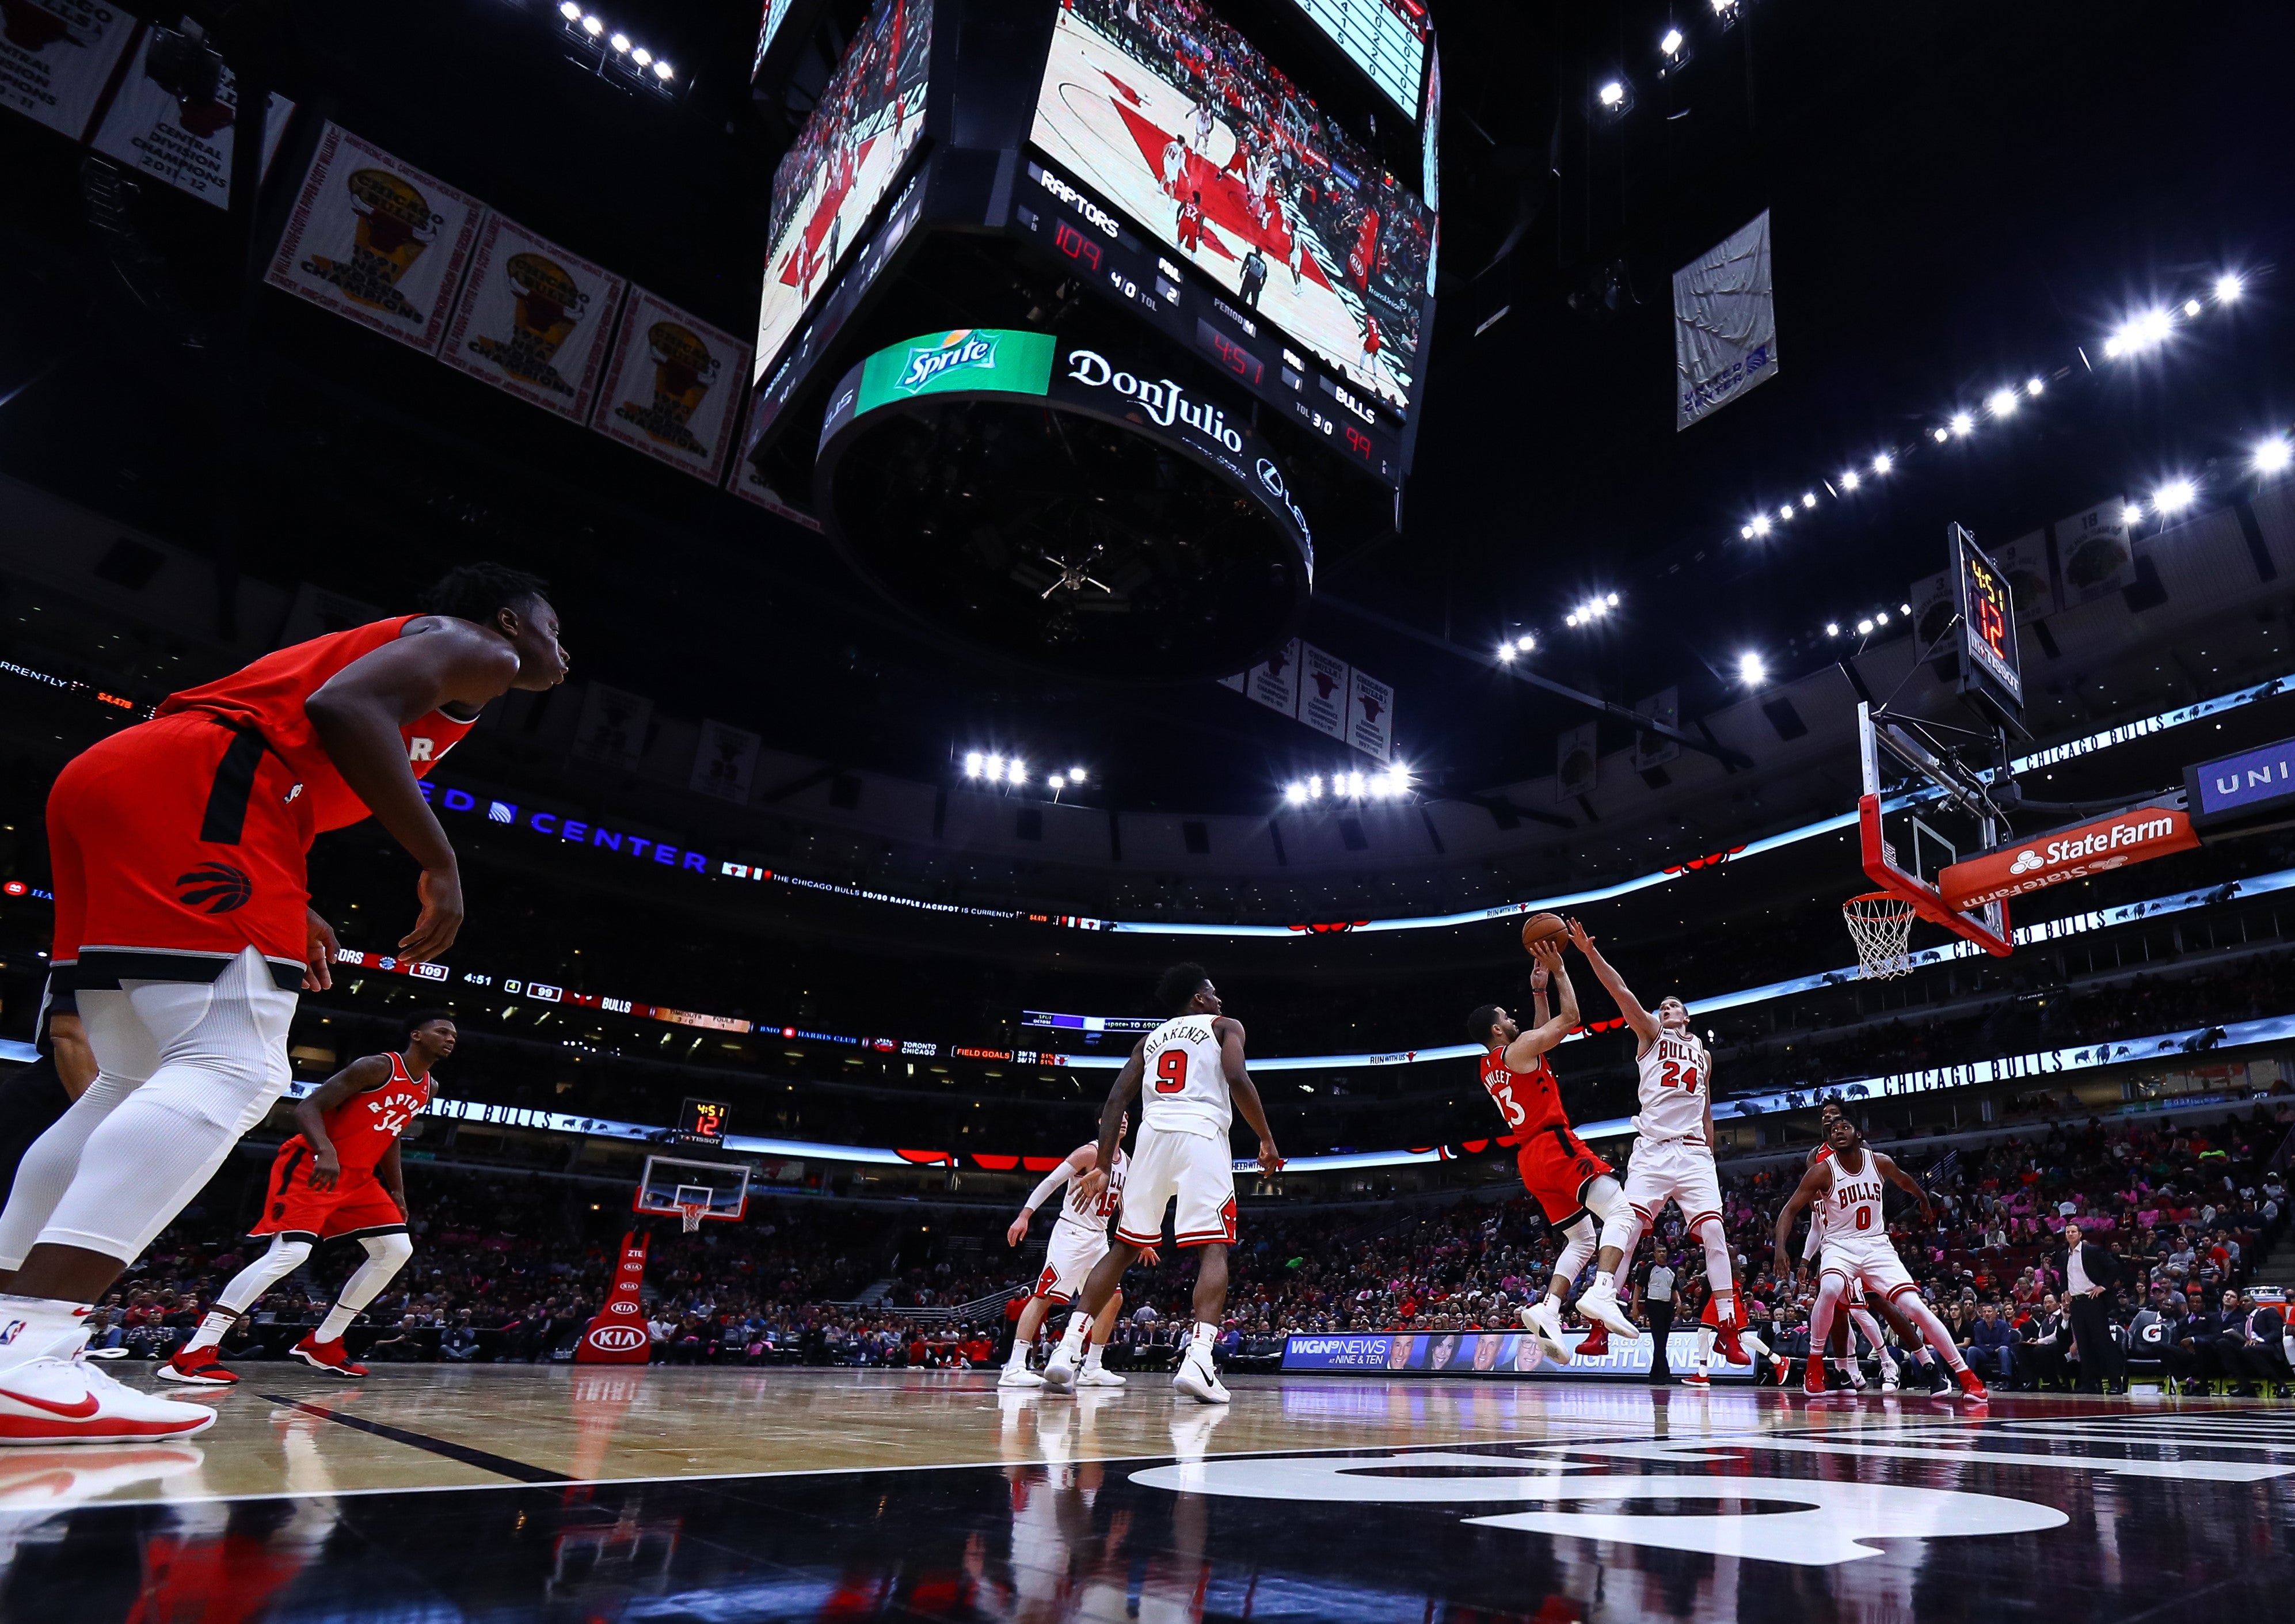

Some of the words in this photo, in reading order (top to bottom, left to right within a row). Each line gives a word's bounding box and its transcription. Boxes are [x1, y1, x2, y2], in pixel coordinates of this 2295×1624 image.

[1375, 16, 1381, 28] 0
[1373, 32, 1380, 45] 2
[1406, 31, 1412, 43] 0
[1372, 48, 1378, 60] 2
[1404, 46, 1410, 58] 0
[1369, 64, 1376, 76] 0
[1400, 77, 1407, 89] 0
[150, 132, 220, 172] DIVISION
[157, 123, 222, 160] CENTRAL
[131, 138, 226, 188] CHAMPIONS
[357, 174, 444, 225] CHICAGO
[371, 193, 429, 230] BULLS
[1041, 170, 1119, 238] RAPTORS
[1056, 225, 1101, 270] 109
[300, 260, 424, 325] CHAMPIONS
[516, 260, 590, 303] CHICAGO
[1166, 287, 1177, 303] 2
[1141, 292, 1157, 311] TOL
[1214, 298, 1243, 325] PERIOD
[1243, 320, 1254, 334] 4
[467, 341, 575, 398] CHAMPIONS
[903, 338, 987, 389] Sprite
[1215, 334, 1262, 384] 4:51
[1684, 363, 1741, 401] UNITED
[1296, 402, 1310, 418] TOL
[1335, 386, 1375, 425] BULLS
[1346, 427, 1372, 459] 99
[1972, 560, 2005, 612] 4:51
[1980, 598, 2004, 660] 12
[0, 661, 68, 687] RRENTLY
[1308, 650, 1342, 672] CHICAGO
[1985, 649, 2019, 691] TISSOT
[1357, 675, 1388, 696] CHICAGO
[2026, 737, 2099, 771] CHICAGO
[2110, 714, 2164, 745] BULLS
[2216, 760, 2290, 796] UNI
[531, 812, 707, 874] CENTER
[773, 874, 789, 883] THE
[791, 877, 832, 891] CHICAGO
[835, 885, 859, 896] BULLS
[862, 891, 888, 902] 50/50
[890, 896, 920, 908] RAFFLE
[922, 902, 959, 913] JACKPOT
[971, 908, 1014, 919] CURRENTLY
[1487, 909, 1499, 918] RUN
[2046, 910, 2106, 940] BULLS
[419, 965, 442, 977] 109
[464, 973, 492, 986] 4:51
[538, 987, 553, 997] 99
[602, 997, 632, 1013] BULLS
[760, 1025, 780, 1034] BMO
[798, 1030, 831, 1041] HARRIS
[833, 1035, 857, 1044] CLUB
[903, 1041, 937, 1050] TORONTO
[1146, 1026, 1210, 1054] BLAKENEY
[901, 1047, 935, 1056] CHICAGO
[957, 1048, 980, 1057] FIELD
[982, 1050, 1010, 1060] GOALS
[1370, 1055, 1384, 1064] RUN
[1658, 1041, 1704, 1071] BULLS
[1155, 1049, 1188, 1094] 9
[1661, 1062, 1698, 1094] 24
[1883, 1062, 1976, 1096] CHICAGO
[1993, 1050, 2062, 1081] BULLS
[367, 1093, 420, 1116] RAPTO
[483, 1105, 553, 1128] BULLS
[697, 1104, 724, 1117] 4:51
[373, 1109, 408, 1136] 34
[696, 1116, 720, 1136] 12
[691, 1136, 720, 1144] TISSOT
[1232, 1162, 1247, 1170] HEER
[1838, 1182, 1881, 1210] BULLS
[1856, 1205, 1871, 1230] 0
[599, 1332, 635, 1345] KIA
[1666, 1338, 1691, 1347] ERY
[1335, 1355, 1356, 1364] NINE
[1357, 1355, 1364, 1364] &
[1365, 1355, 1383, 1364] TEN
[1668, 1349, 1748, 1368] NEW
